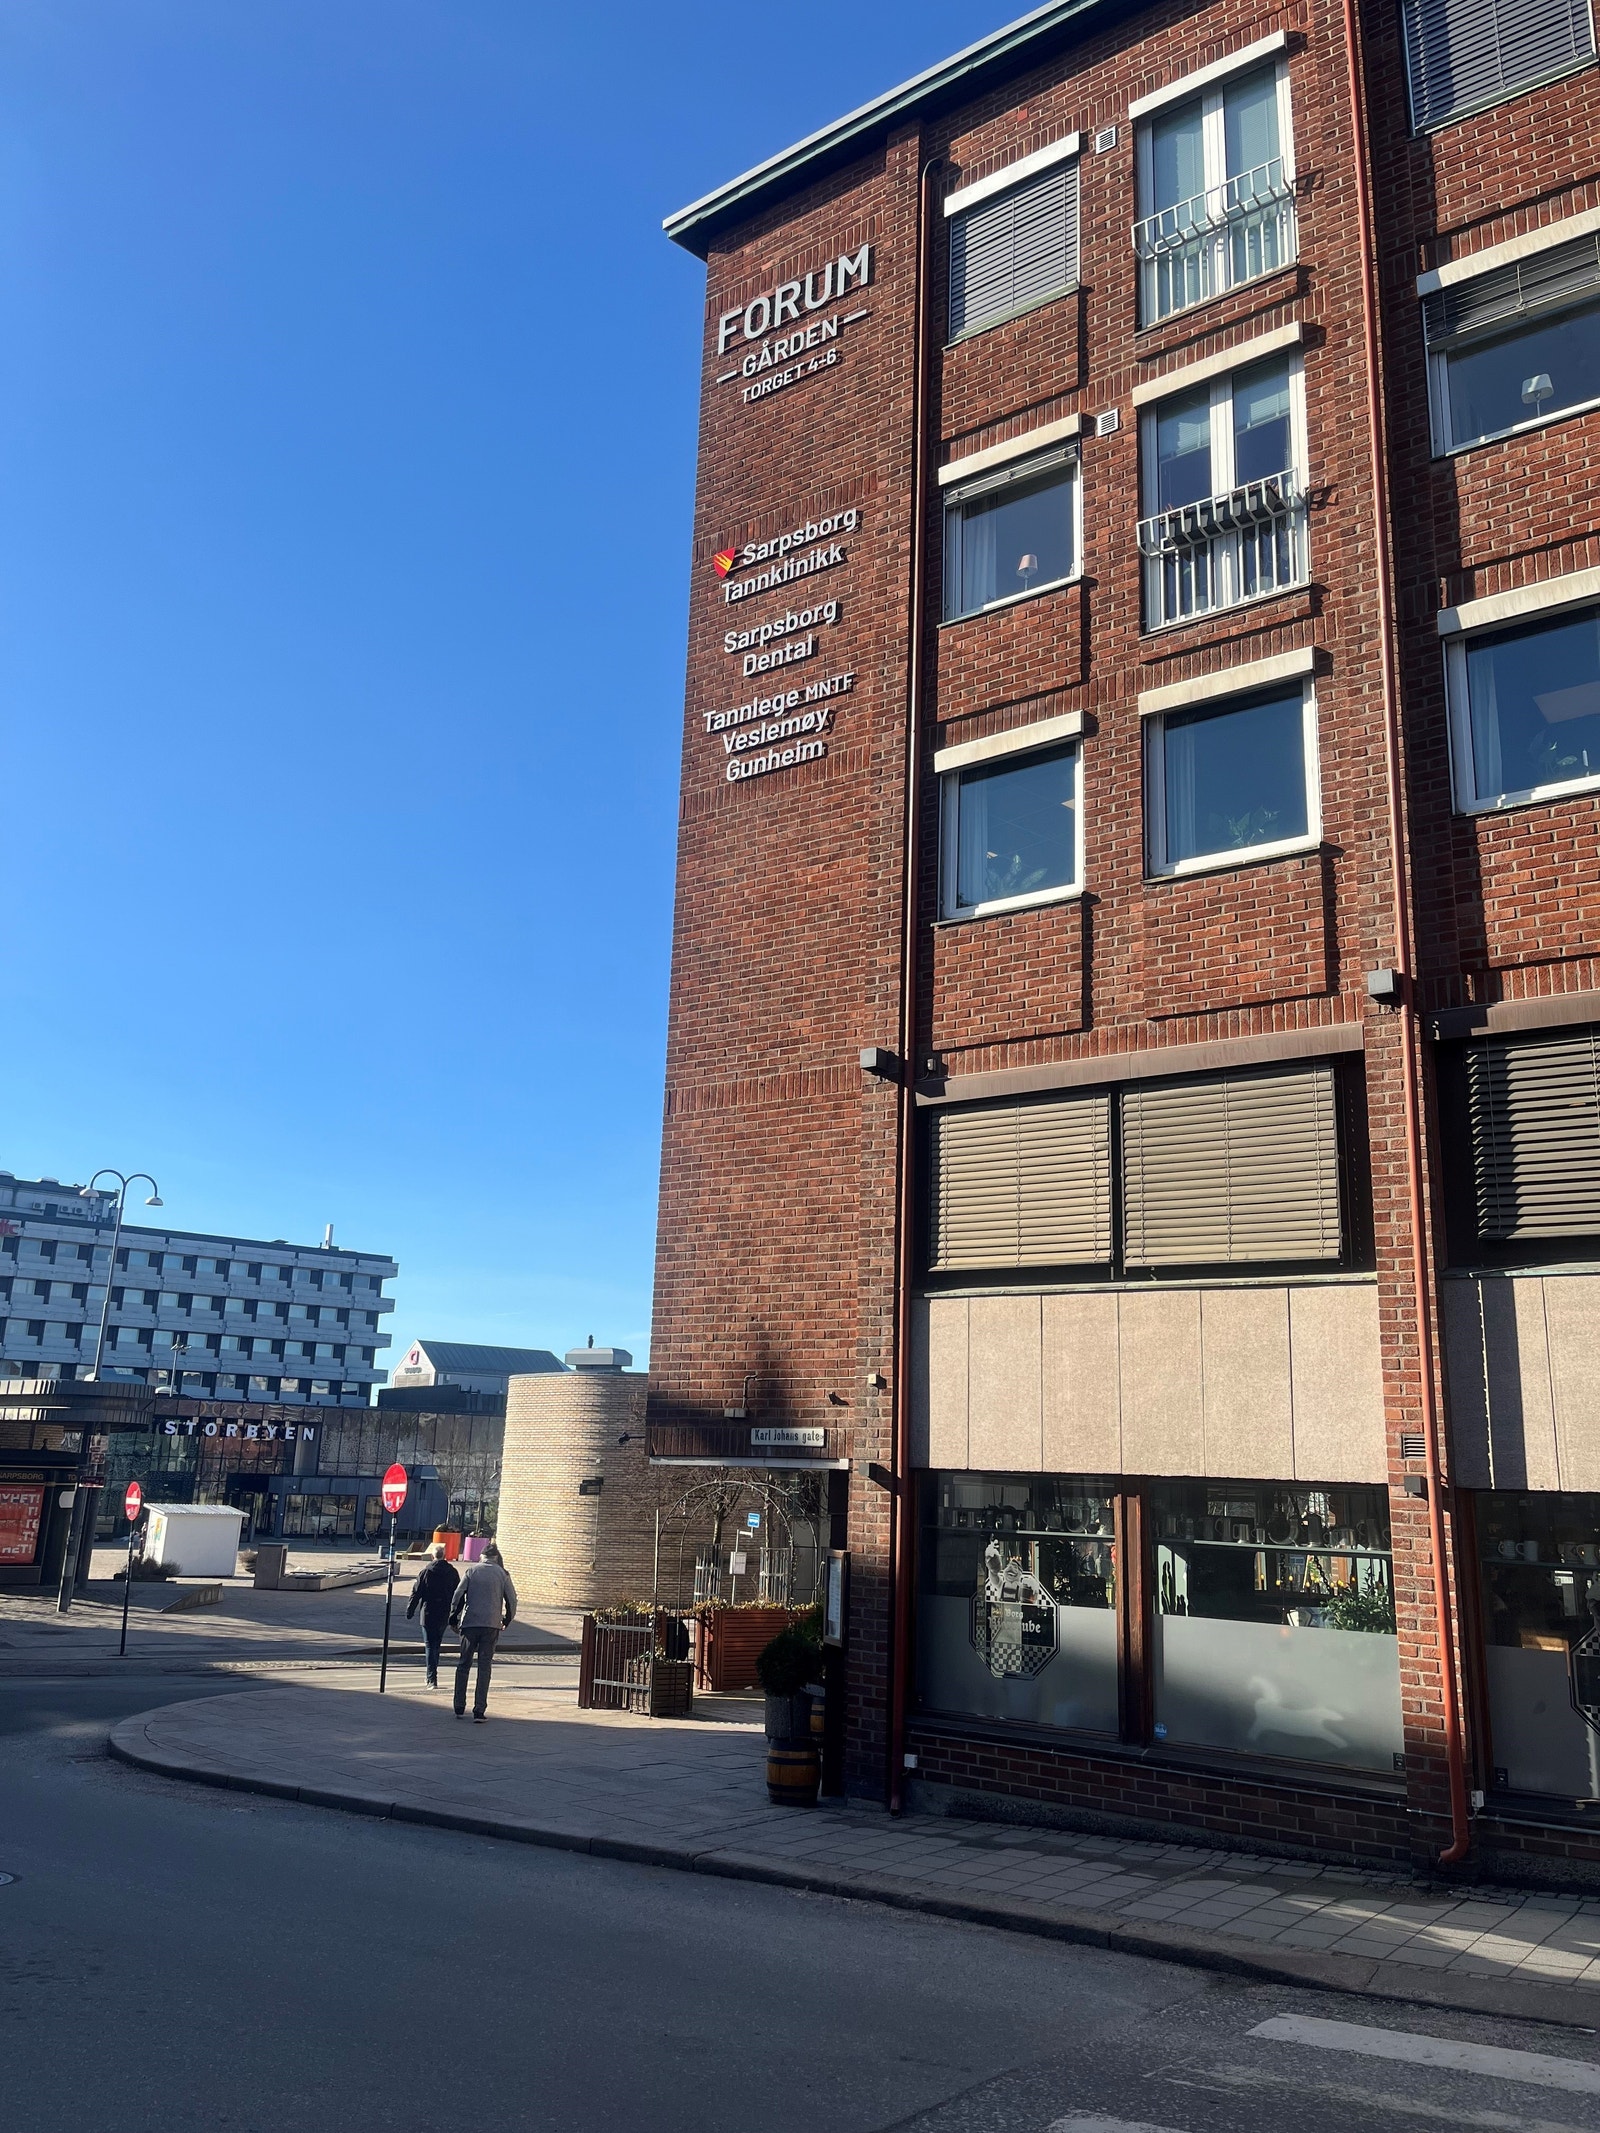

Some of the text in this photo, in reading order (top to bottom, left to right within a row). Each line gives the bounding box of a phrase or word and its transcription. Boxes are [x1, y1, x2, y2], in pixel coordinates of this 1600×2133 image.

[718, 243, 870, 355] FORUM
[742, 314, 838, 377] GÅRDEN
[741, 348, 837, 403] TORGET 4-6
[742, 508, 858, 566] Sarpsborg
[721, 543, 843, 603] Tannklinikk
[724, 600, 838, 653] Sarpsborg
[742, 633, 813, 677] Dental
[703, 672, 855, 733] Tannlege MNTF
[722, 707, 829, 754] Veslemøy
[726, 740, 824, 782] Gunheim
[164, 1420, 315, 1441] STORBYEN
[754, 1429, 771, 1441] Karl
[802, 1430, 820, 1444] gate
[0, 1493, 40, 1504] YHET!
